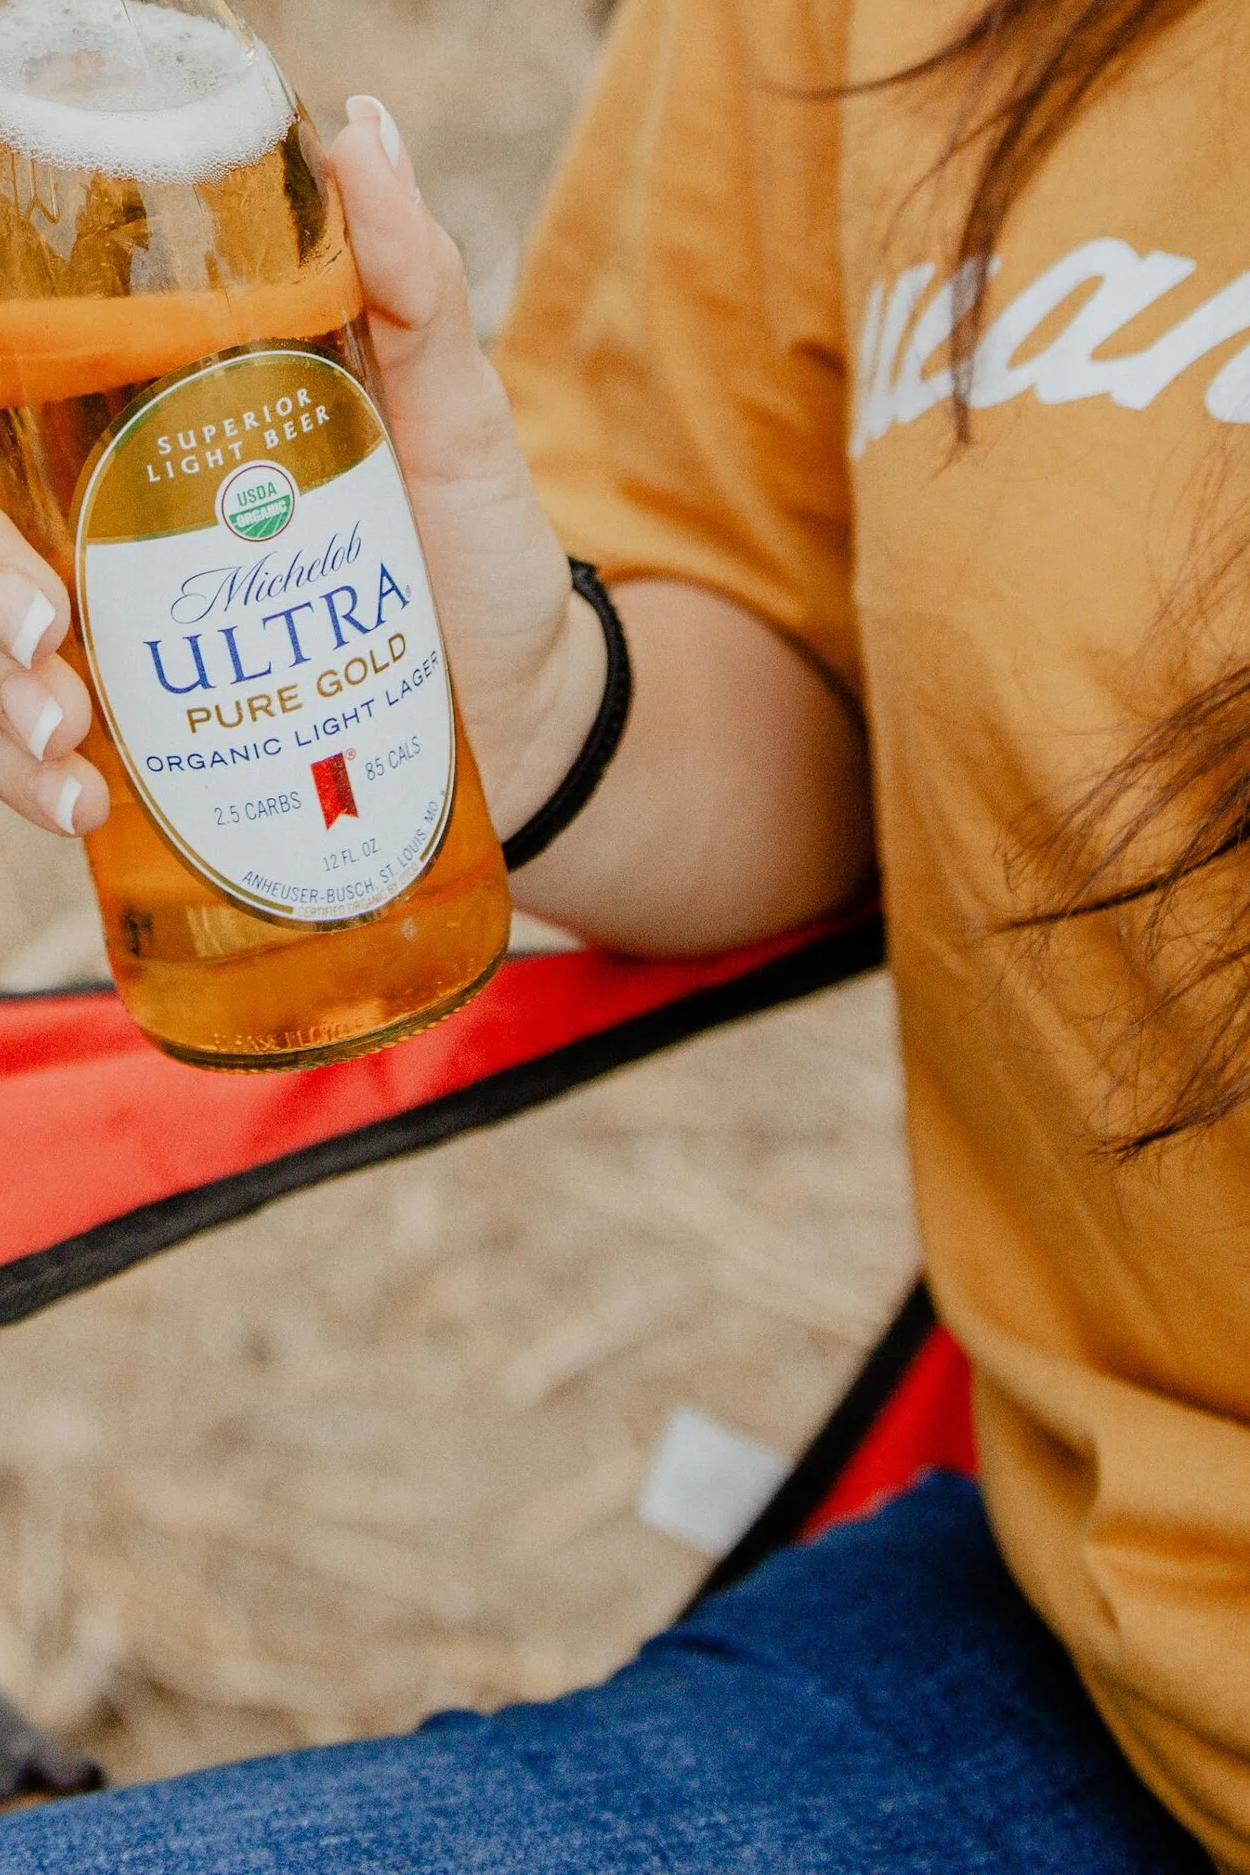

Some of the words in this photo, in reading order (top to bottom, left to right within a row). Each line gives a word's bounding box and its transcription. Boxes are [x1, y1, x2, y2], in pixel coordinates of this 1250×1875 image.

[146, 441, 244, 483] LIGHT
[263, 404, 331, 450] BEER
[156, 388, 312, 455] SUPERIOR
[236, 481, 278, 506] USDA
[236, 499, 288, 529] ORGANIC
[171, 521, 362, 624] Michelob
[143, 562, 410, 695] ULTRA
[186, 683, 304, 734] PURE
[316, 632, 407, 698] GOLD
[146, 737, 282, 773] ORGANIC
[294, 698, 375, 748] LIGHT
[385, 650, 440, 707] LAGER
[365, 757, 385, 781] 85
[388, 735, 422, 769] CALS
[214, 805, 241, 826] 2.5
[244, 791, 302, 821] CARBS
[424, 800, 440, 825] MO
[322, 852, 340, 873] 12
